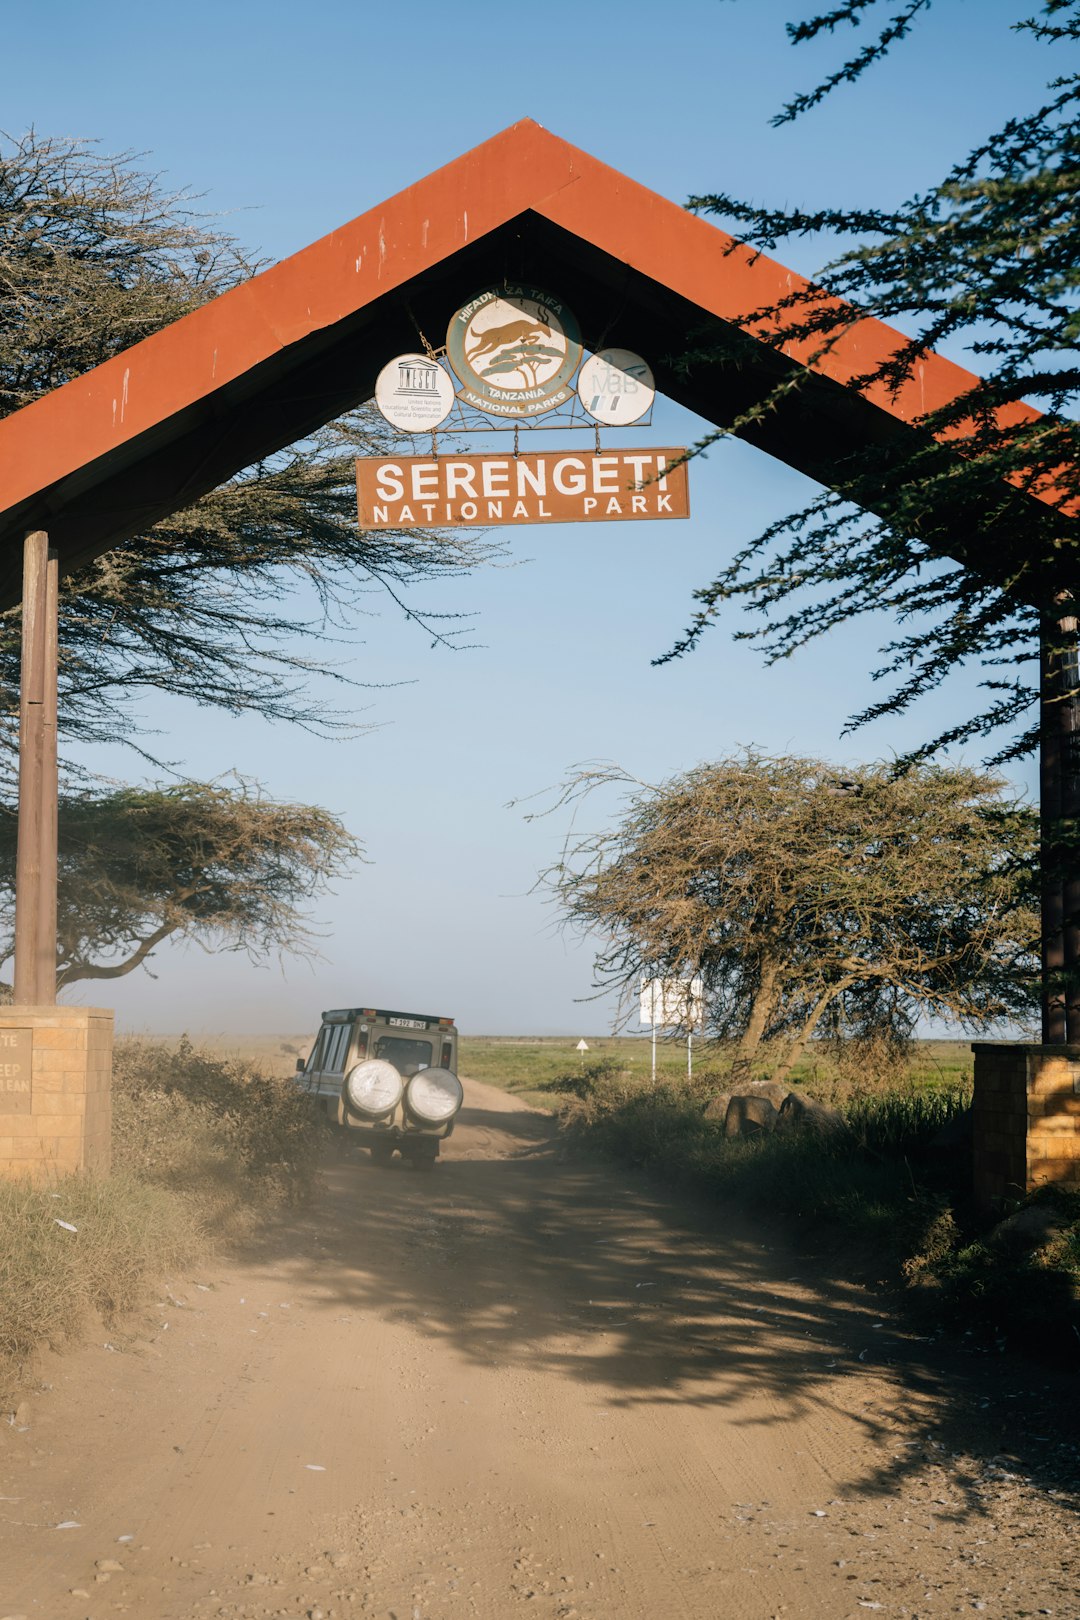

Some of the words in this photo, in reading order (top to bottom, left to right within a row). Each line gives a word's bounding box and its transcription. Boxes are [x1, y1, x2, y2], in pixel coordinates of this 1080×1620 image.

[458, 288, 500, 323] HIFADHI
[506, 286, 524, 296] ZA
[530, 289, 563, 315] TAIFA
[399, 369, 437, 389] UNESCO
[466, 392, 525, 414] NATIONAL
[528, 391, 566, 412] PARKS
[488, 387, 546, 401] TANZANIA
[376, 455, 668, 502] SERENGETI
[373, 500, 552, 523] NATIONAL
[583, 494, 673, 515] PARK
